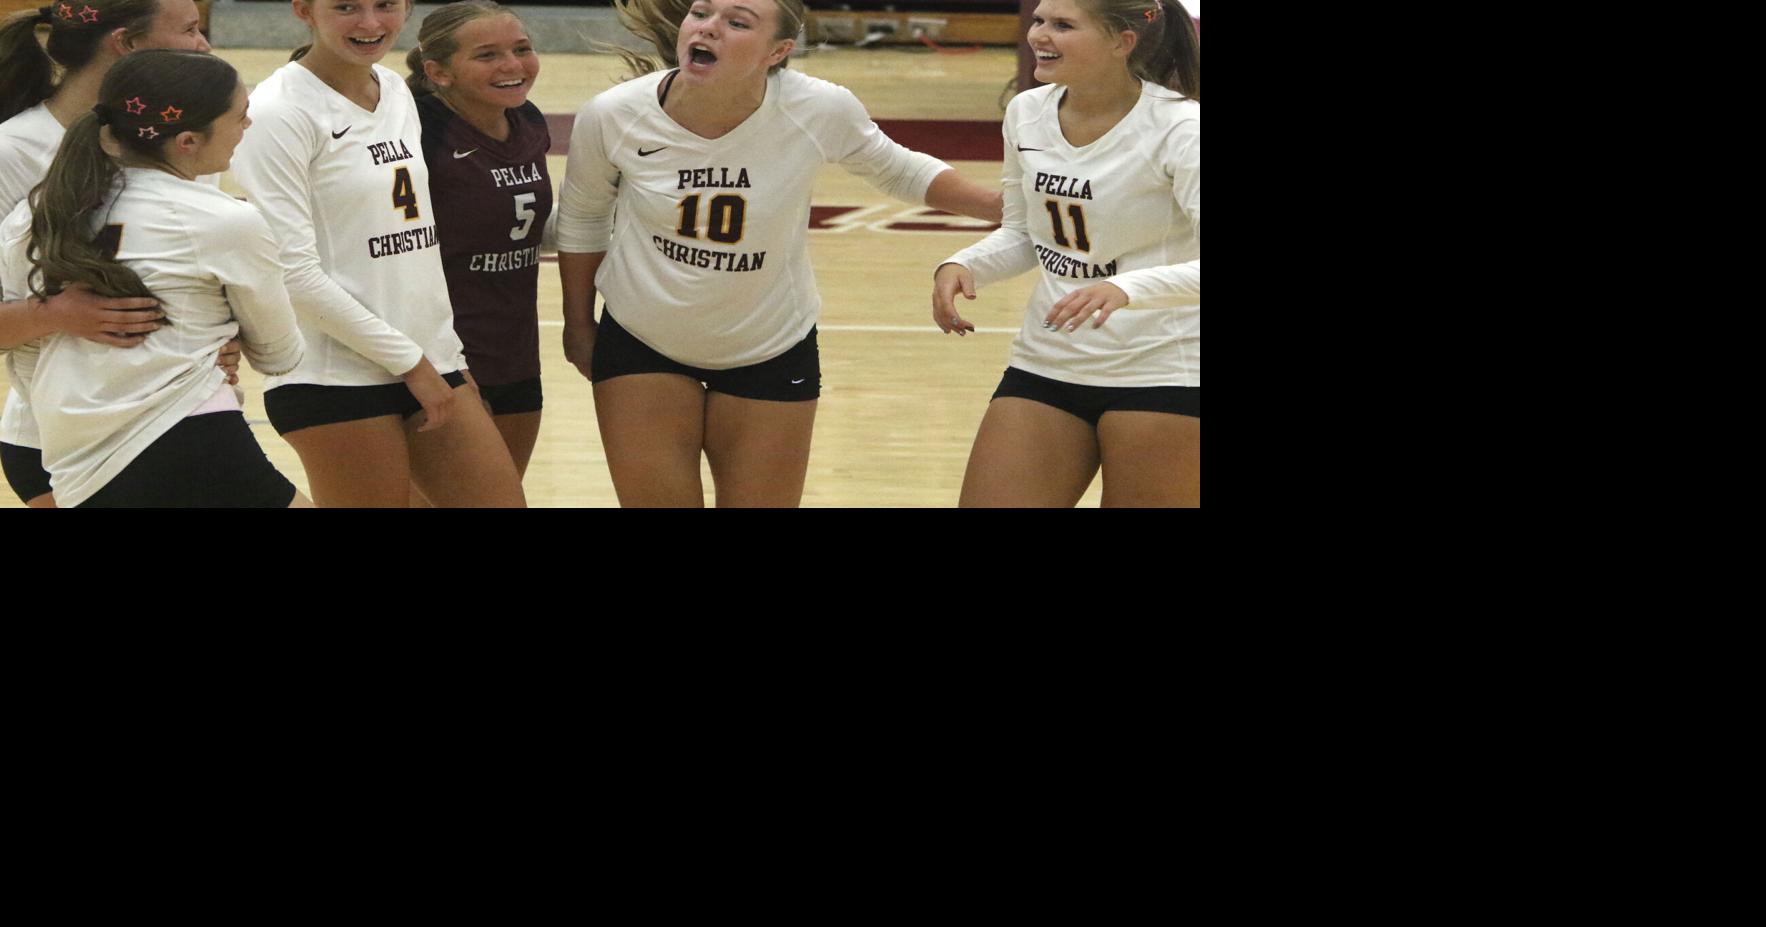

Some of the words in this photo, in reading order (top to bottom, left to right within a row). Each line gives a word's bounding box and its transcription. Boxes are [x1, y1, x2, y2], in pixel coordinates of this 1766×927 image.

[367, 139, 413, 165] PELLA
[490, 162, 542, 188] PELLA
[677, 167, 751, 189] PELLA
[1034, 172, 1093, 200] PELLA
[392, 165, 420, 222] 4
[509, 192, 537, 241] 5
[675, 192, 747, 245] 10
[1044, 198, 1091, 255] 11
[469, 244, 541, 272] CHRISTIA
[652, 235, 766, 272] CHRISTIAN
